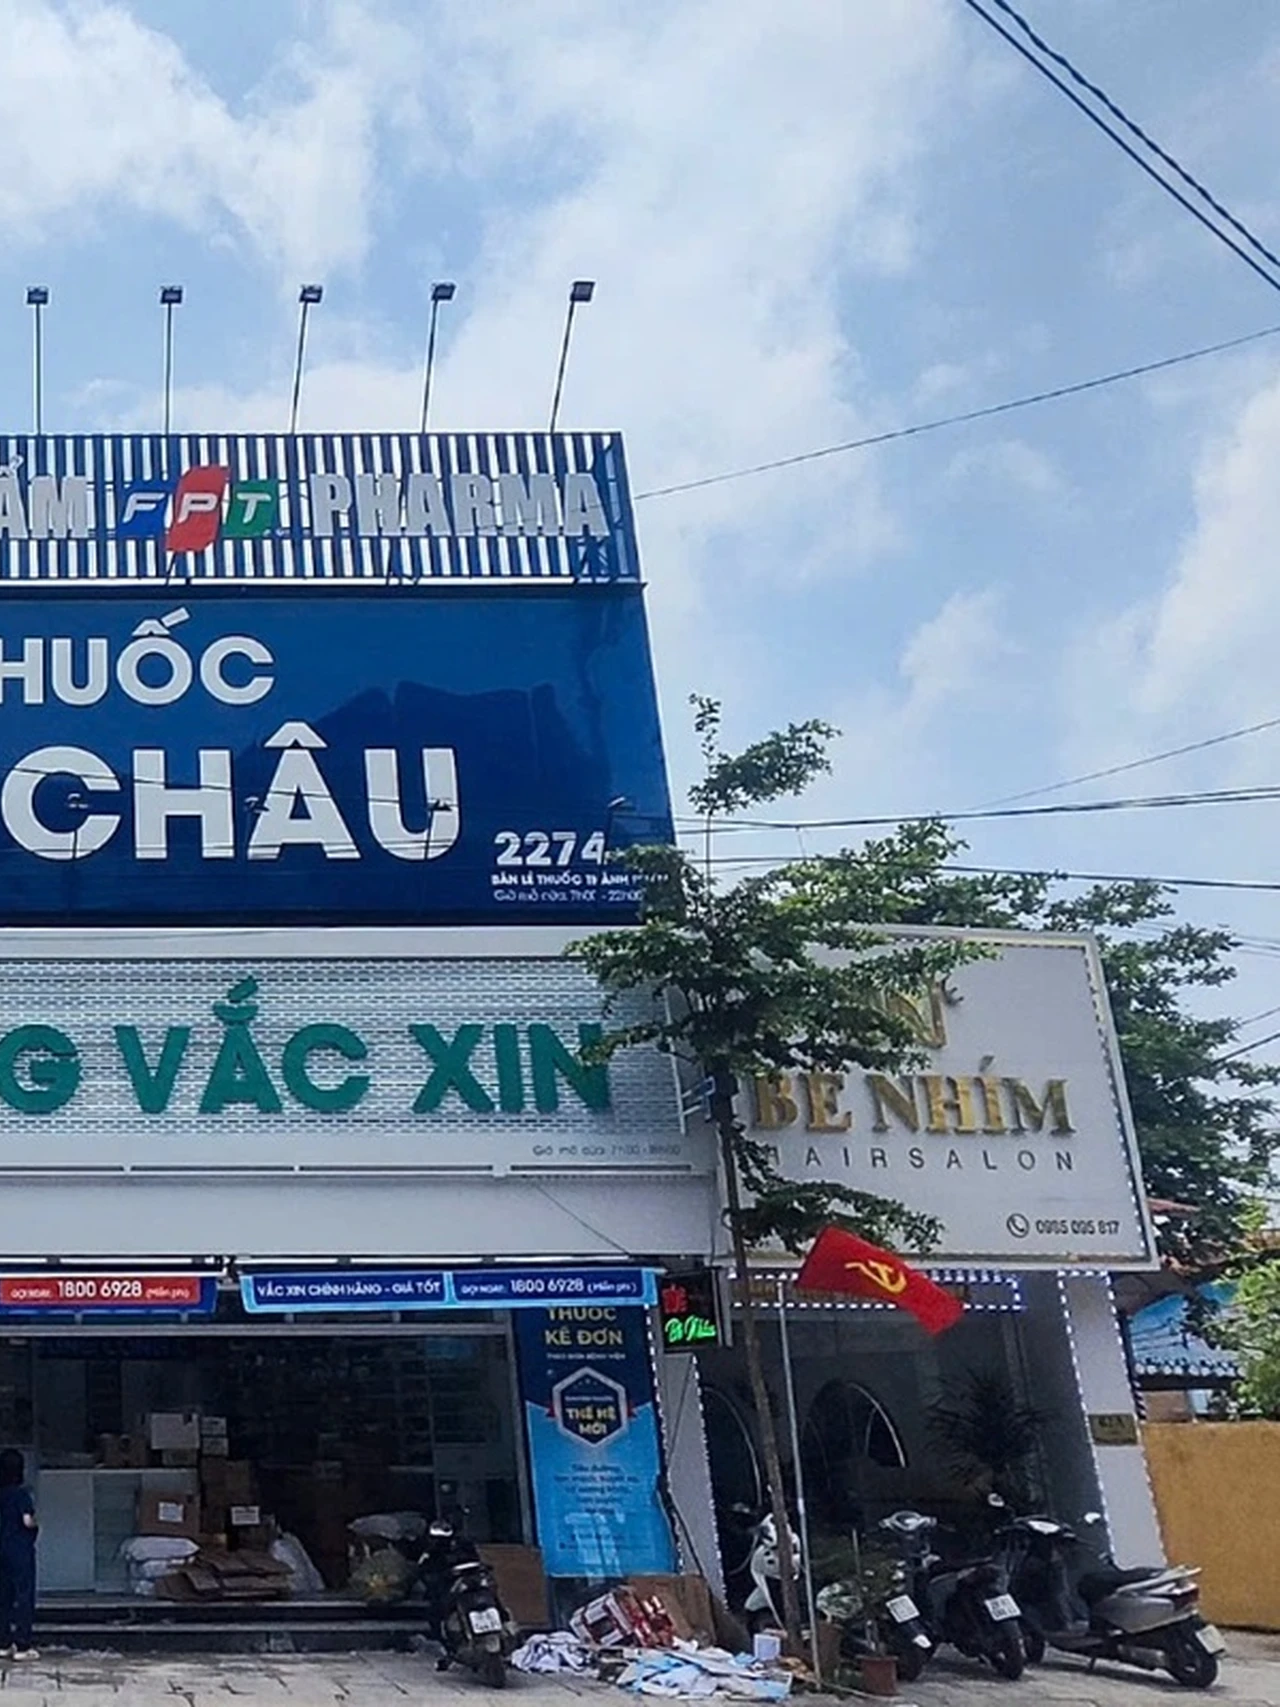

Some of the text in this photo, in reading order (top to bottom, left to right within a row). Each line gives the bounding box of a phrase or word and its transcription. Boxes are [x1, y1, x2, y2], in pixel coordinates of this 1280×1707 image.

[310, 472, 612, 538] PHARMA
[0, 720, 462, 862] CHÂU
[494, 831, 607, 866] 2274
[113, 974, 371, 1113] VẮC
[409, 1022, 614, 1114] XIN
[865, 1055, 1076, 1136] NHÍM
[57, 1281, 96, 1297] 1800
[100, 1281, 143, 1297] 6928
[416, 1277, 441, 1294] TỐT
[510, 1279, 545, 1293] 1800
[547, 1278, 584, 1293] 6928
[544, 1325, 623, 1346] KÊ ĐƠN
